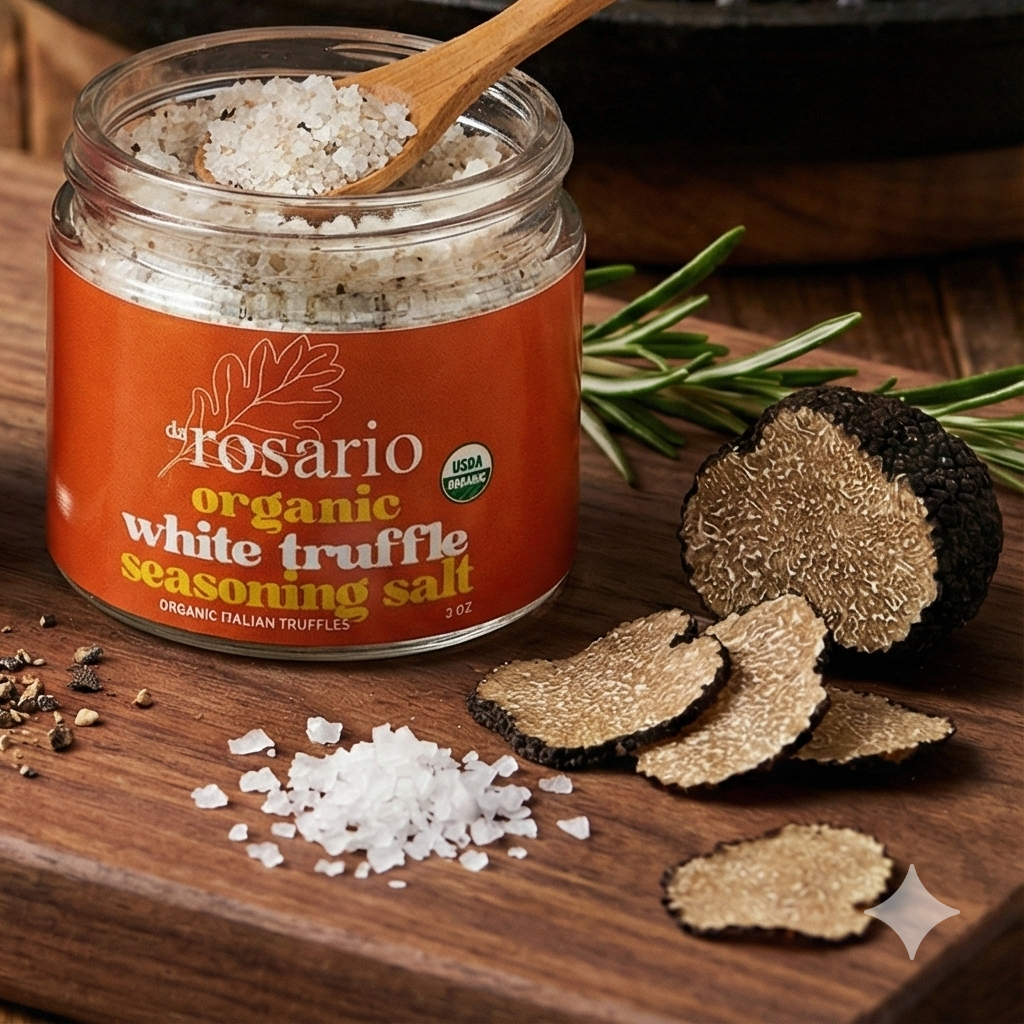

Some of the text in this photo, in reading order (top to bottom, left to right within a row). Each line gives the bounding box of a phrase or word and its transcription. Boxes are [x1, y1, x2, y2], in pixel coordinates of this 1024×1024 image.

[189, 420, 423, 478] rosario
[452, 455, 483, 474] USDA
[191, 484, 401, 534] organic
[121, 511, 469, 573] white truffle
[121, 552, 474, 623] seasoning salt
[456, 601, 473, 616] OZ
[159, 598, 217, 621] ORGANIC
[279, 618, 351, 631] TRUFFLES
